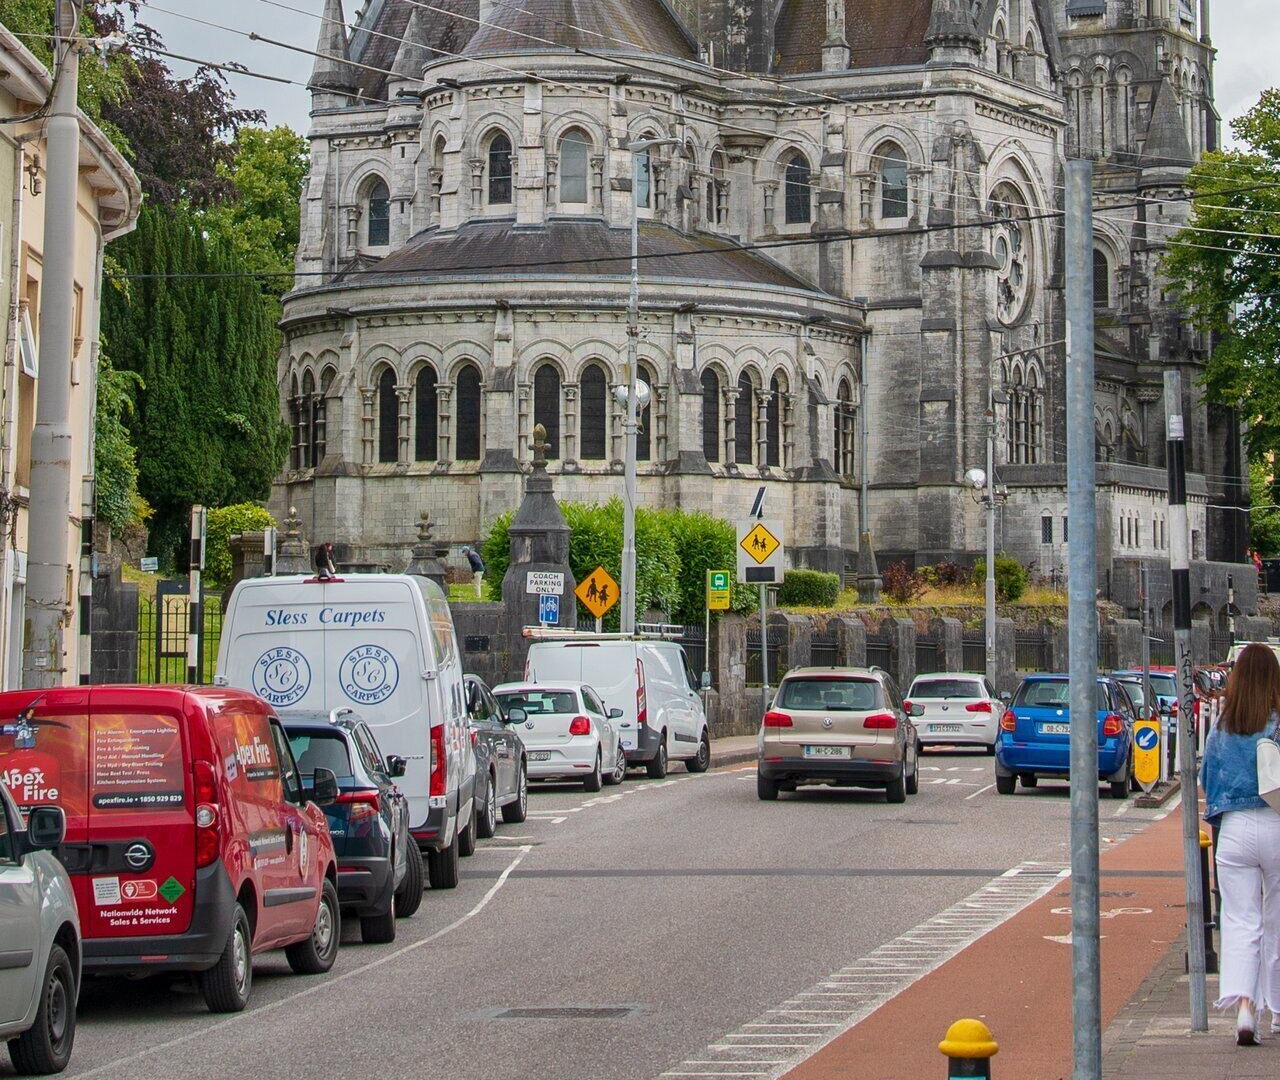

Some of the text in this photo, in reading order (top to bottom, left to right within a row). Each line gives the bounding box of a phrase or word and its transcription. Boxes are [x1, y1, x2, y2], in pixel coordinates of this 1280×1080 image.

[265, 607, 386, 627] Sless Carpets
[260, 649, 301, 667] SLESS
[348, 647, 390, 664] SLESS
[259, 683, 305, 703] CARPETS
[346, 683, 392, 701] CARPETS
[253, 736, 271, 764] Fire
[1, 769, 45, 789] Apex
[23, 785, 59, 801] Fire
[98, 796, 134, 805] apexfire.ie
[100, 907, 178, 918] Nationwide Network
[140, 916, 171, 925] Services
